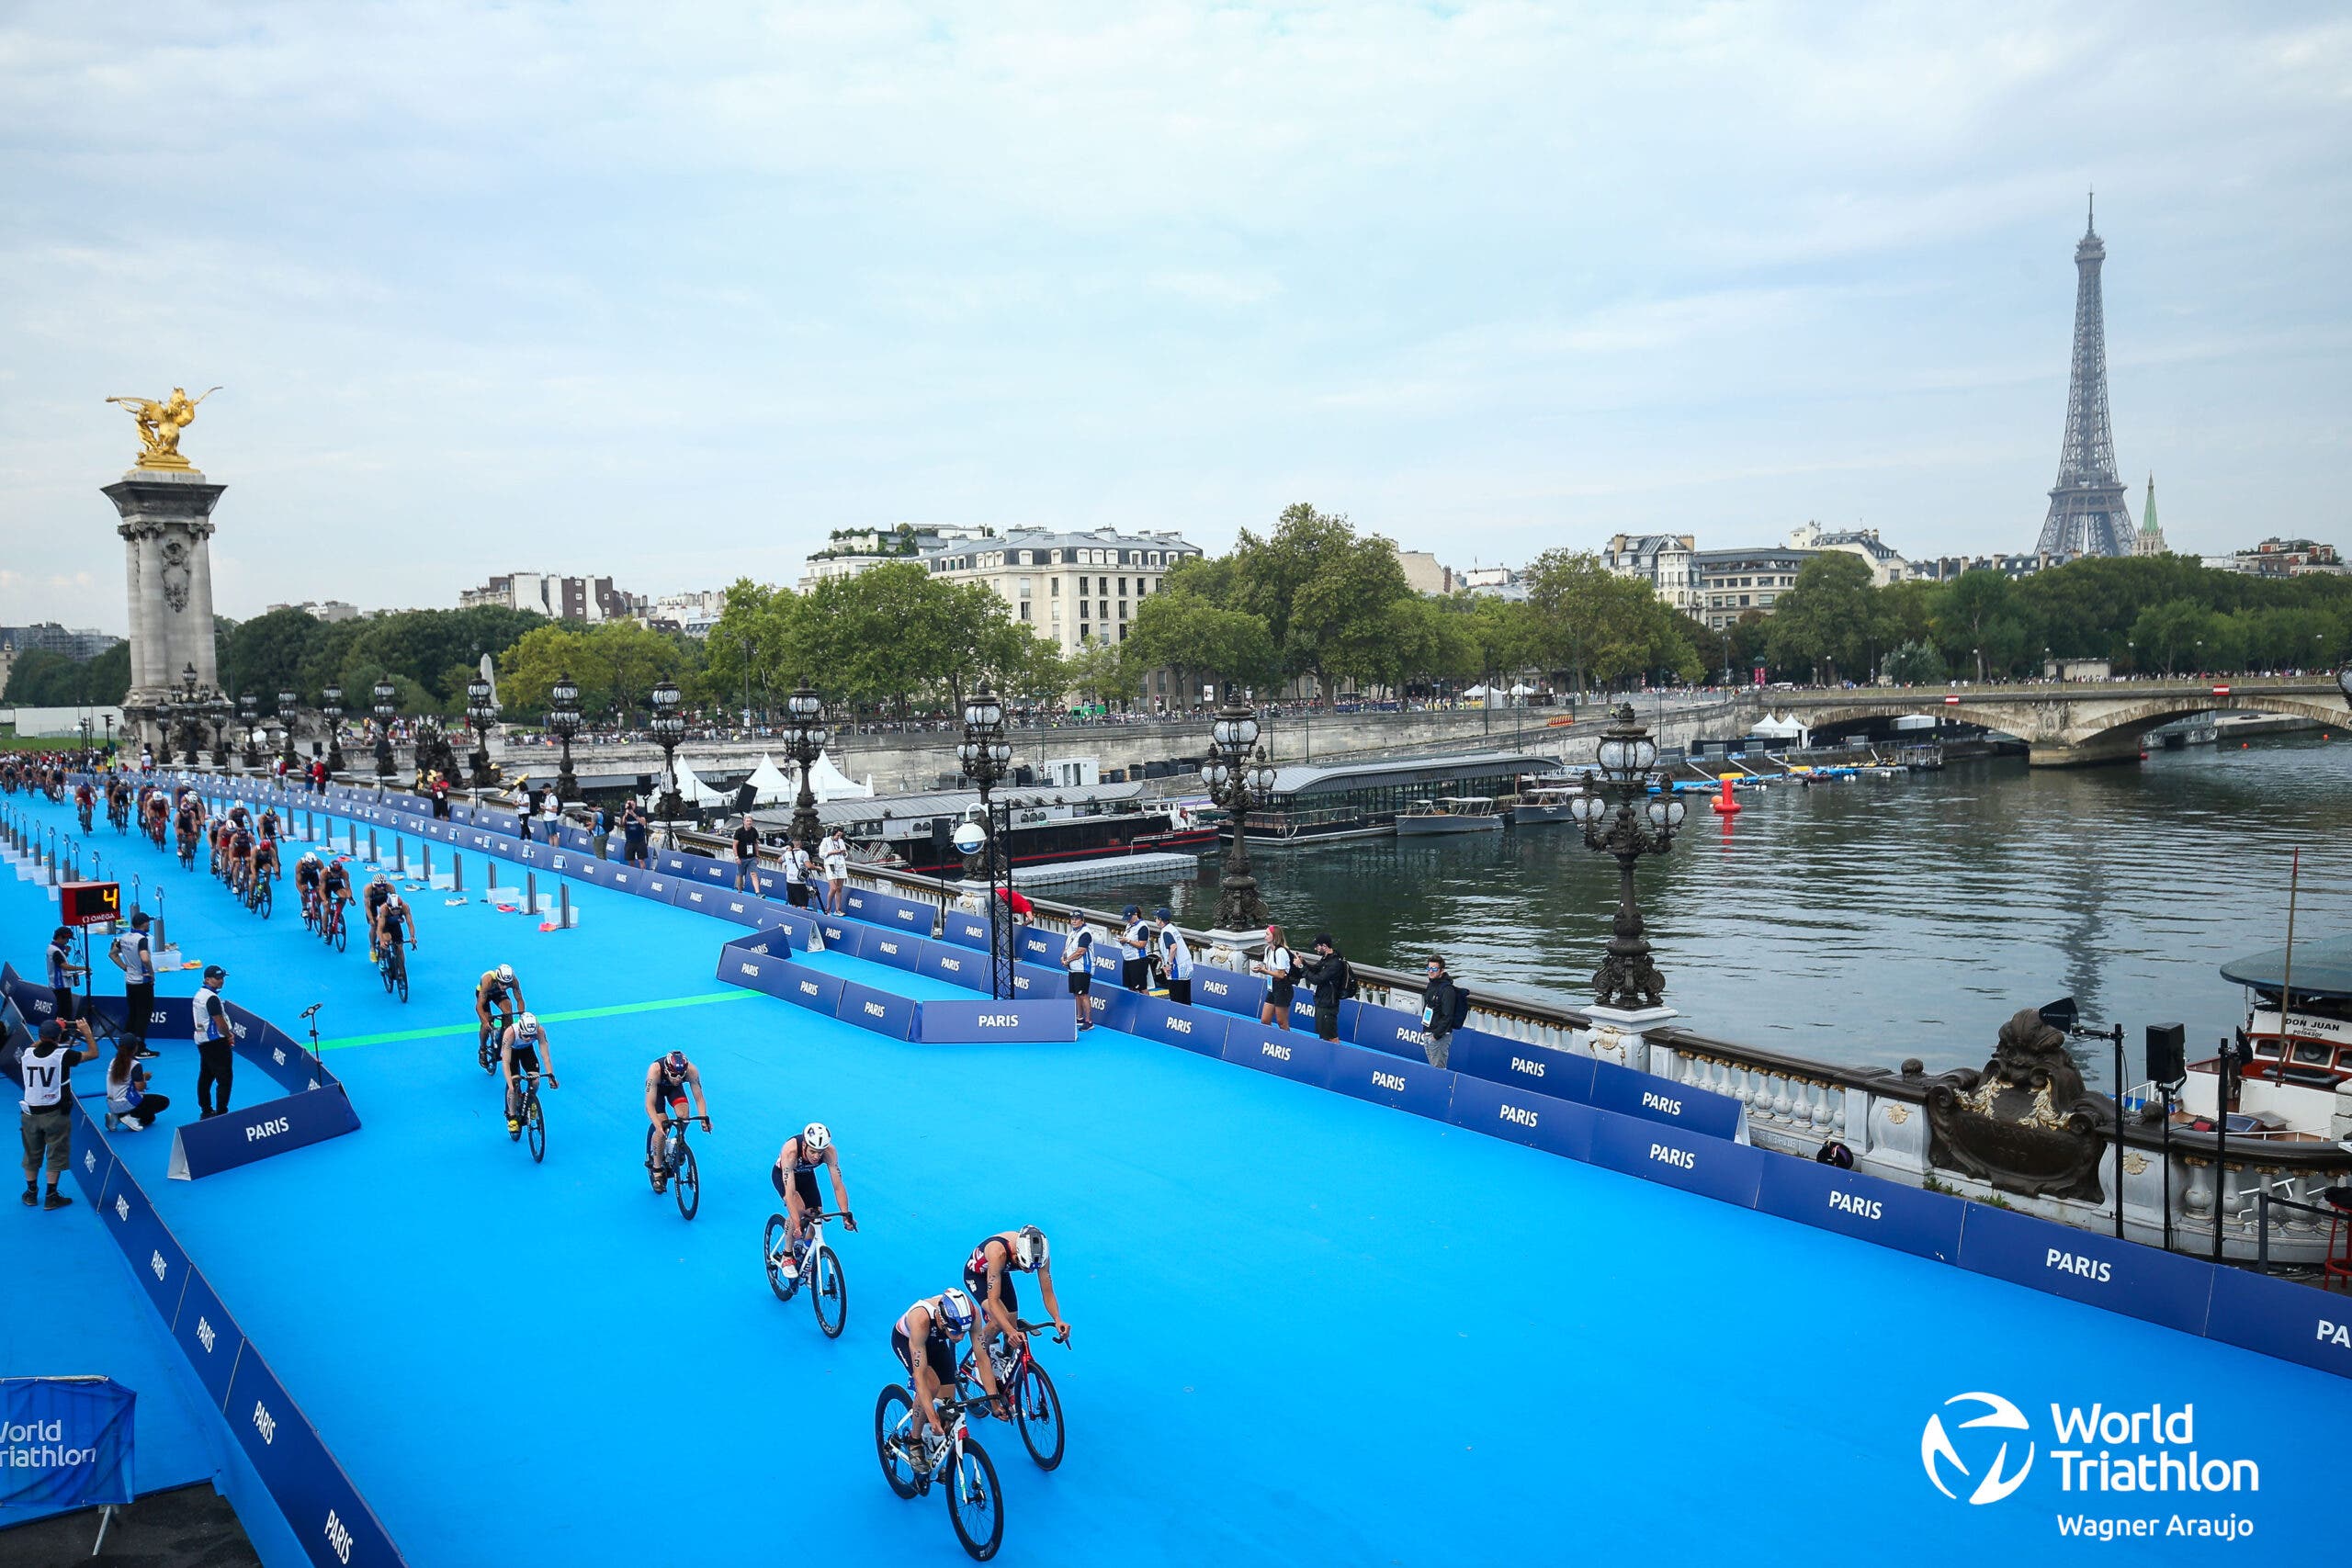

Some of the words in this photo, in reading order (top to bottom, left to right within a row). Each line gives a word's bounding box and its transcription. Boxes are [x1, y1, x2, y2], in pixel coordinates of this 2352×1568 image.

[103, 888, 118, 909] 4
[90, 912, 116, 921] OMEGA
[898, 909, 914, 921] PARIS
[825, 928, 842, 941] PARIS
[966, 926, 983, 938] PARIS
[880, 942, 898, 954] PARIS
[1028, 940, 1046, 953] PARIS
[741, 964, 759, 976] PARIS
[942, 958, 959, 971] PARIS
[1095, 956, 1115, 970] PARIS
[800, 981, 818, 996] PARIS
[1013, 976, 1030, 990] ARIS
[1204, 981, 1227, 995] PARIS
[34, 999, 52, 1013] PARIS
[865, 1002, 885, 1017] PARIS
[1295, 1002, 1314, 1017] PARI
[979, 1015, 1018, 1026] PARIS
[1167, 1017, 1192, 1033] PARIS
[2286, 1019, 2307, 1027] DON
[2311, 1021, 2340, 1032] JUAN
[1262, 1043, 1291, 1060] PARIS
[1511, 1057, 1544, 1077] PARIS
[27, 1066, 55, 1088] TV
[1373, 1071, 1405, 1091] PARIS
[1643, 1092, 1681, 1115] PARIS
[1500, 1105, 1538, 1127] PARIS
[246, 1117, 288, 1141] PARIS
[1650, 1144, 1694, 1168] PARIS
[1829, 1190, 1882, 1219] PARIS
[151, 1250, 167, 1281] PARIS
[2047, 1248, 2110, 1281] PARIS
[987, 1281, 993, 1290] 5
[198, 1316, 215, 1352] PARIS
[254, 1401, 276, 1444] PARIS
[0, 1444, 96, 1467] riathlon
[325, 1509, 353, 1564] PARIS
